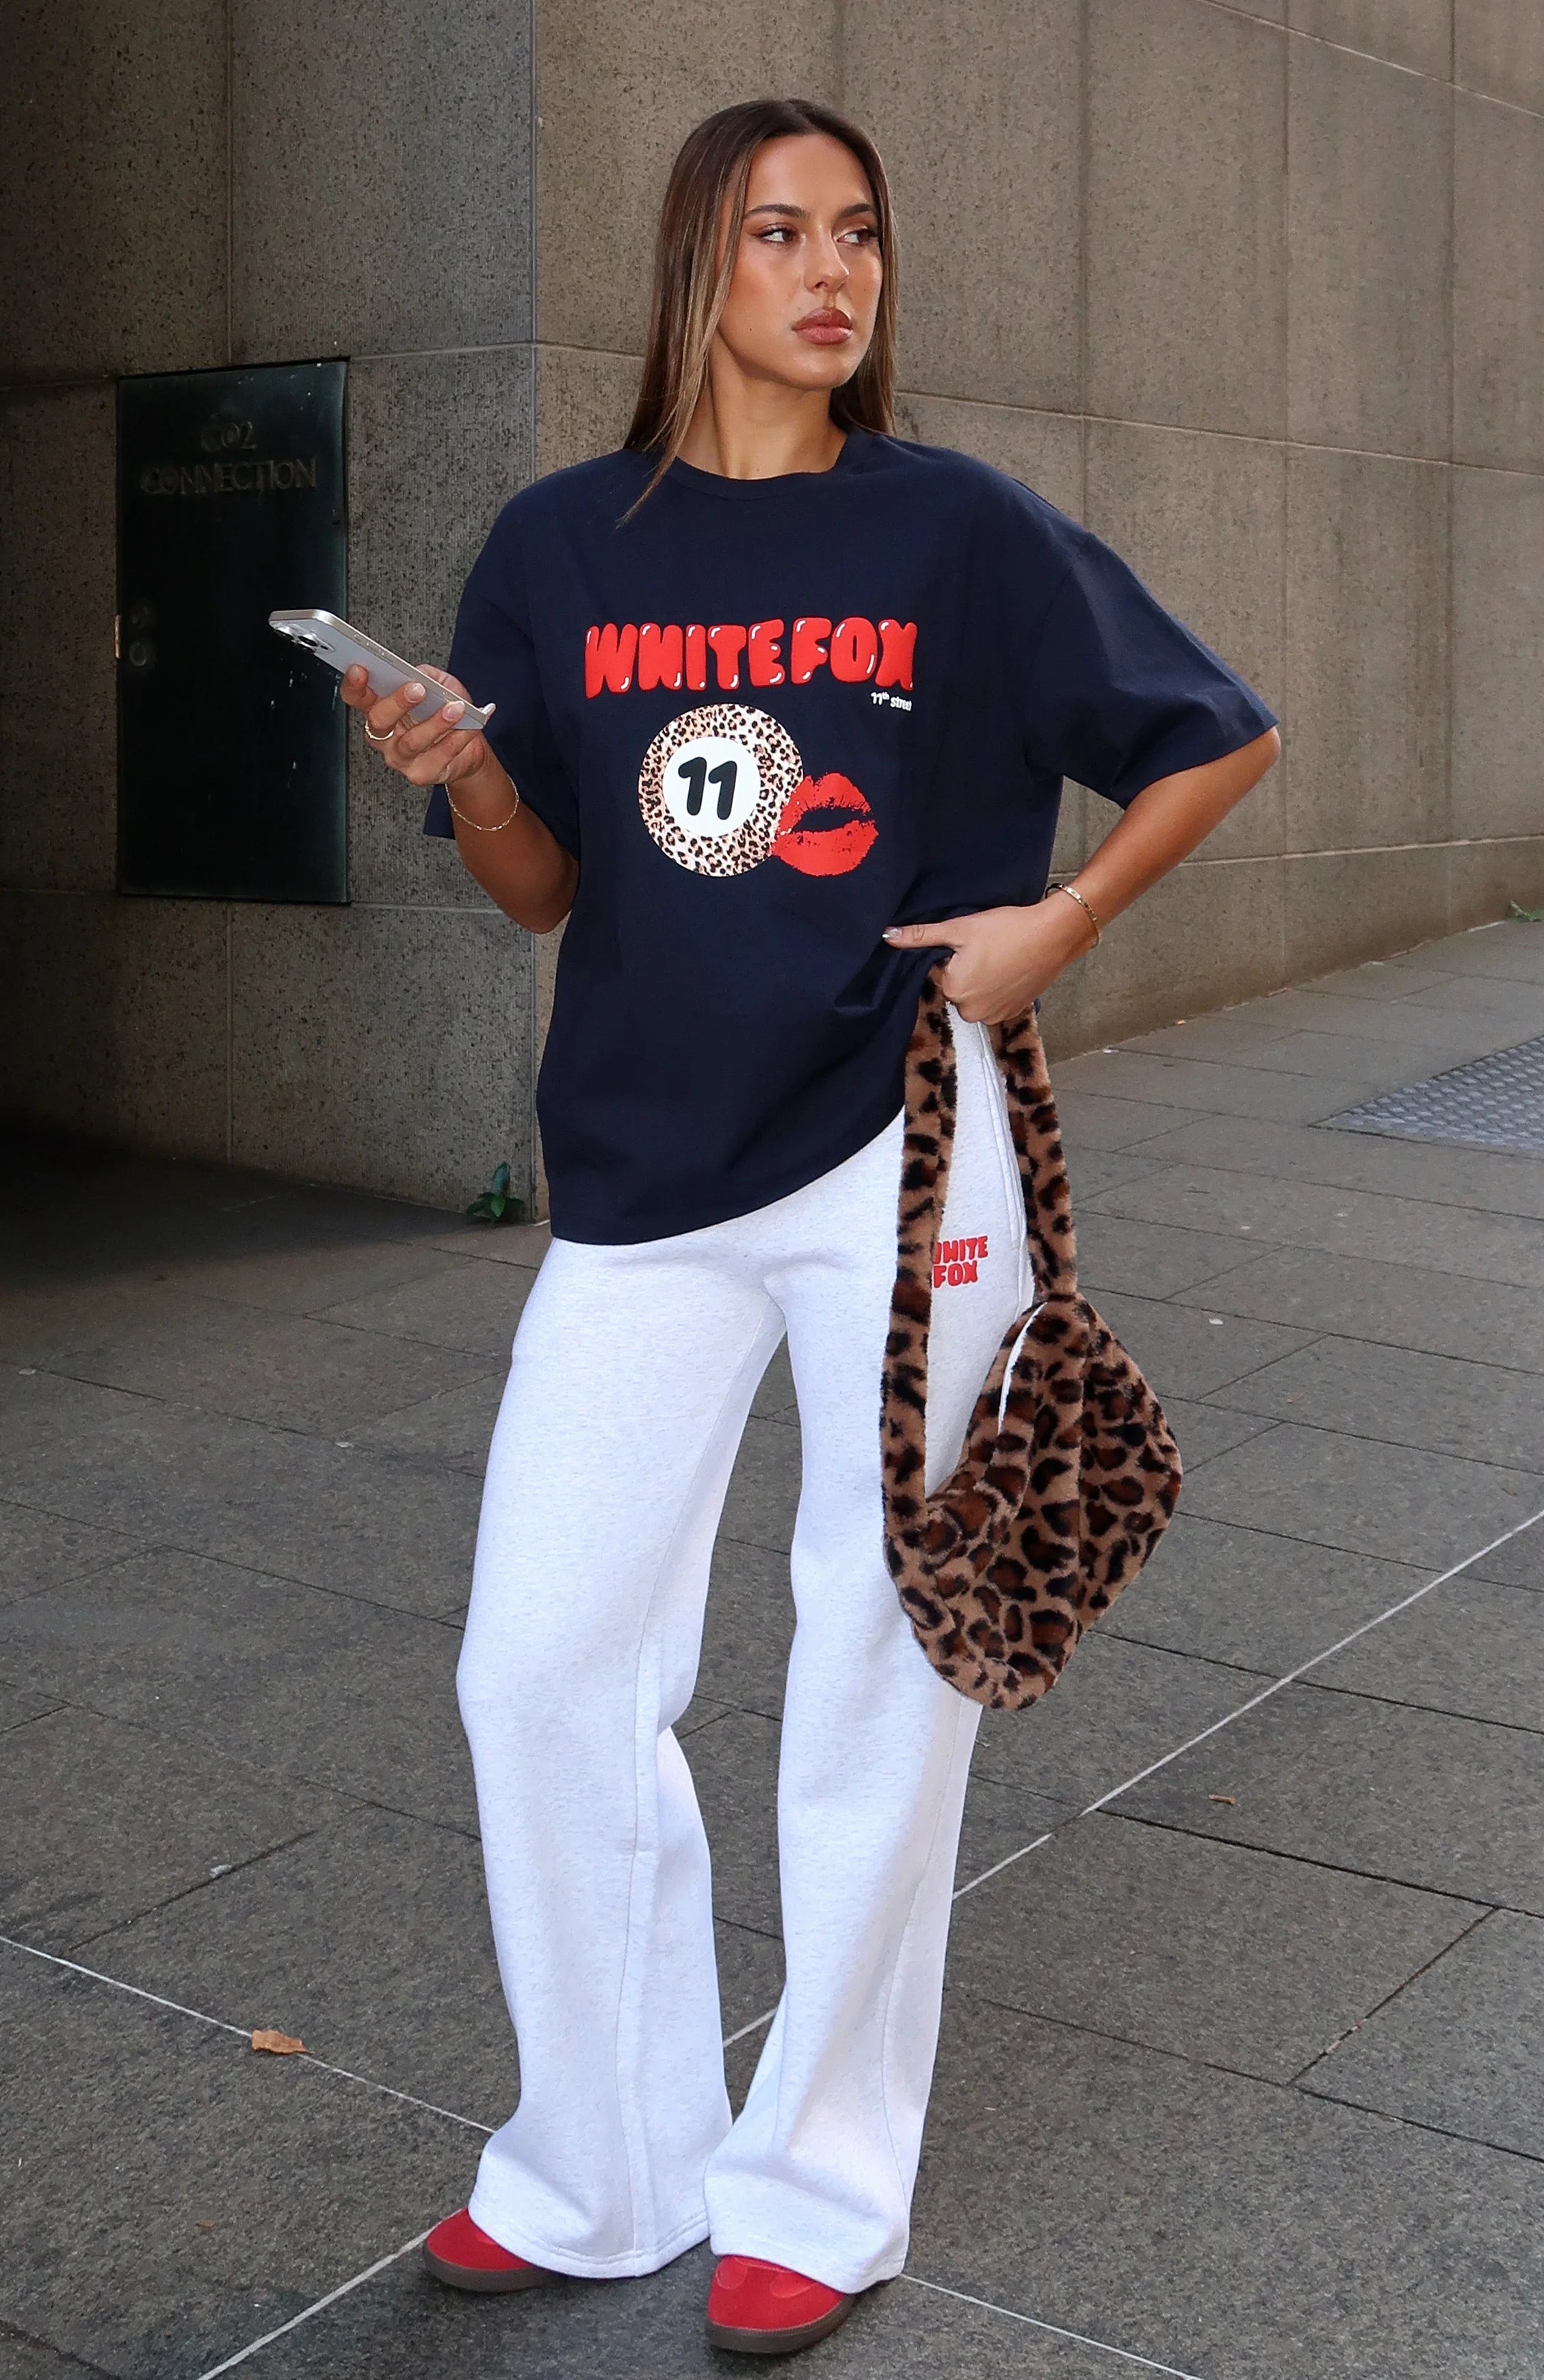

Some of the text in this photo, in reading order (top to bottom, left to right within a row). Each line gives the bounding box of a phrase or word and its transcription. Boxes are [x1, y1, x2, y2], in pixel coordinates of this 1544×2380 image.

[140, 457, 317, 495] CONNECTION
[585, 617, 917, 698] WHITE FOX
[678, 756, 737, 820] 11
[933, 1260, 978, 1288] FOX
